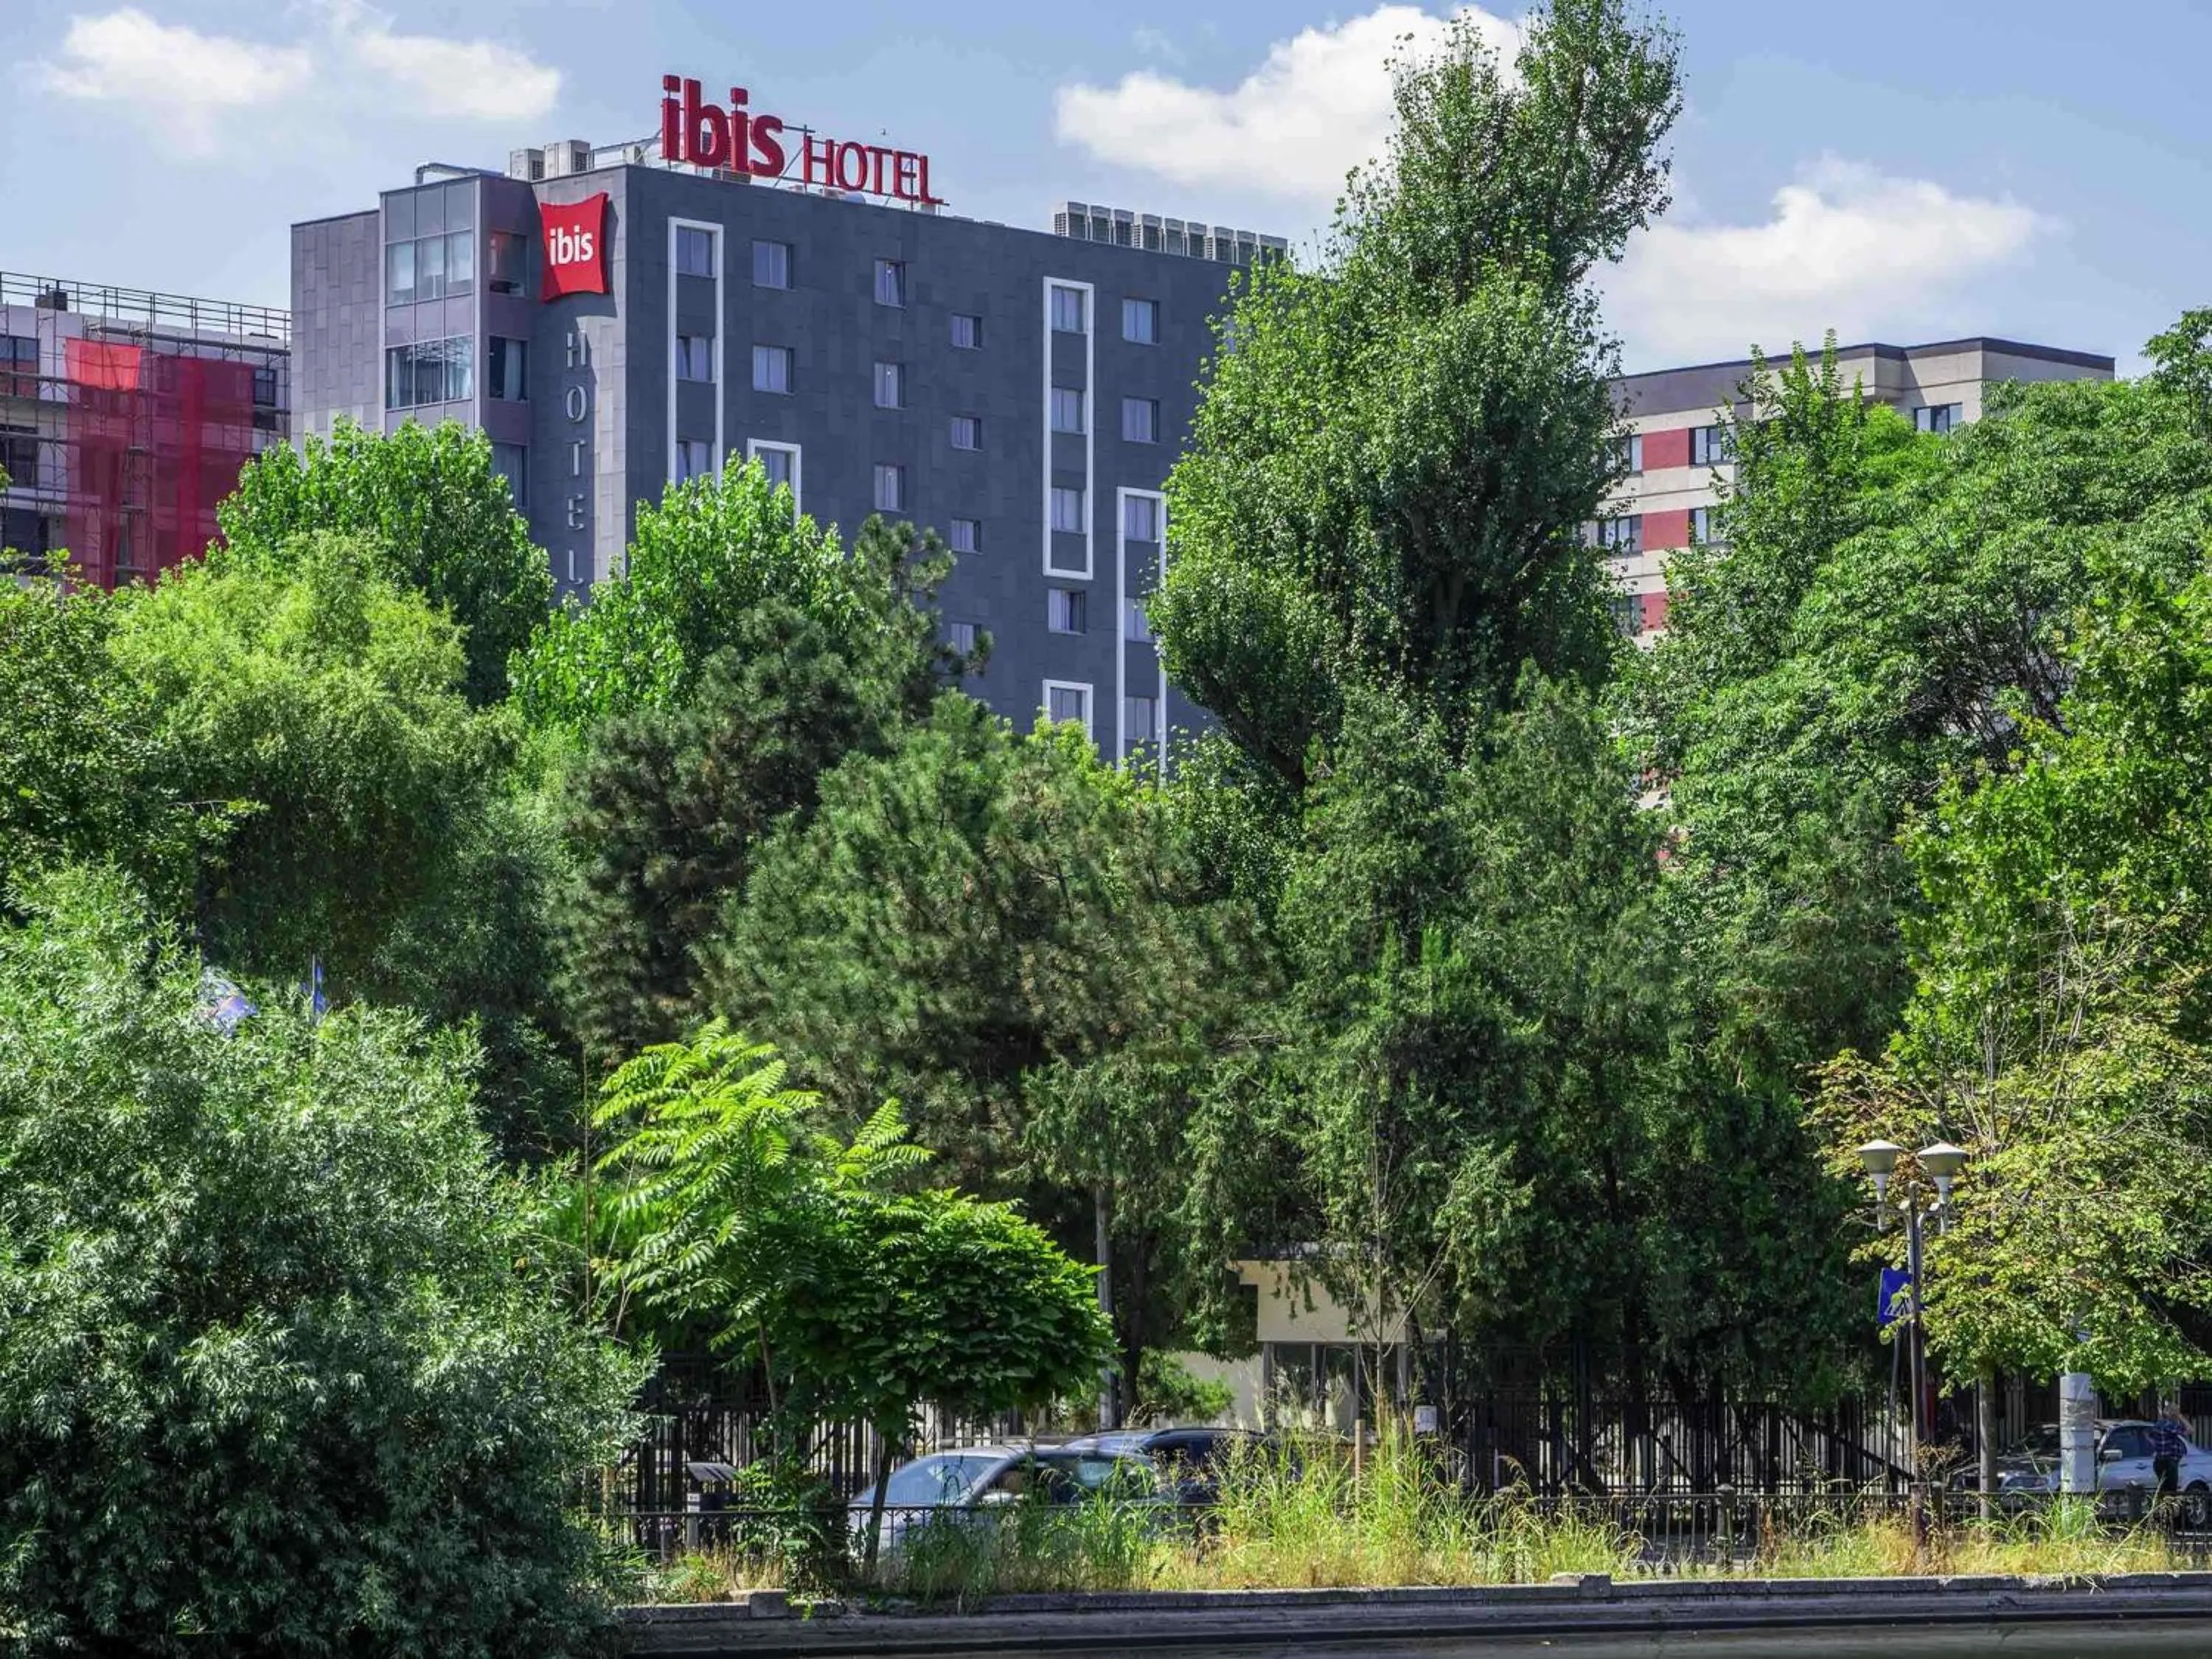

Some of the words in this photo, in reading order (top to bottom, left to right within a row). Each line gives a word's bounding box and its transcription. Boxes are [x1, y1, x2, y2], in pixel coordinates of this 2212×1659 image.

[662, 74, 785, 178] ibis
[804, 134, 945, 205] HOTEL
[549, 224, 594, 266] ibis
[566, 330, 588, 585] HOTEL
